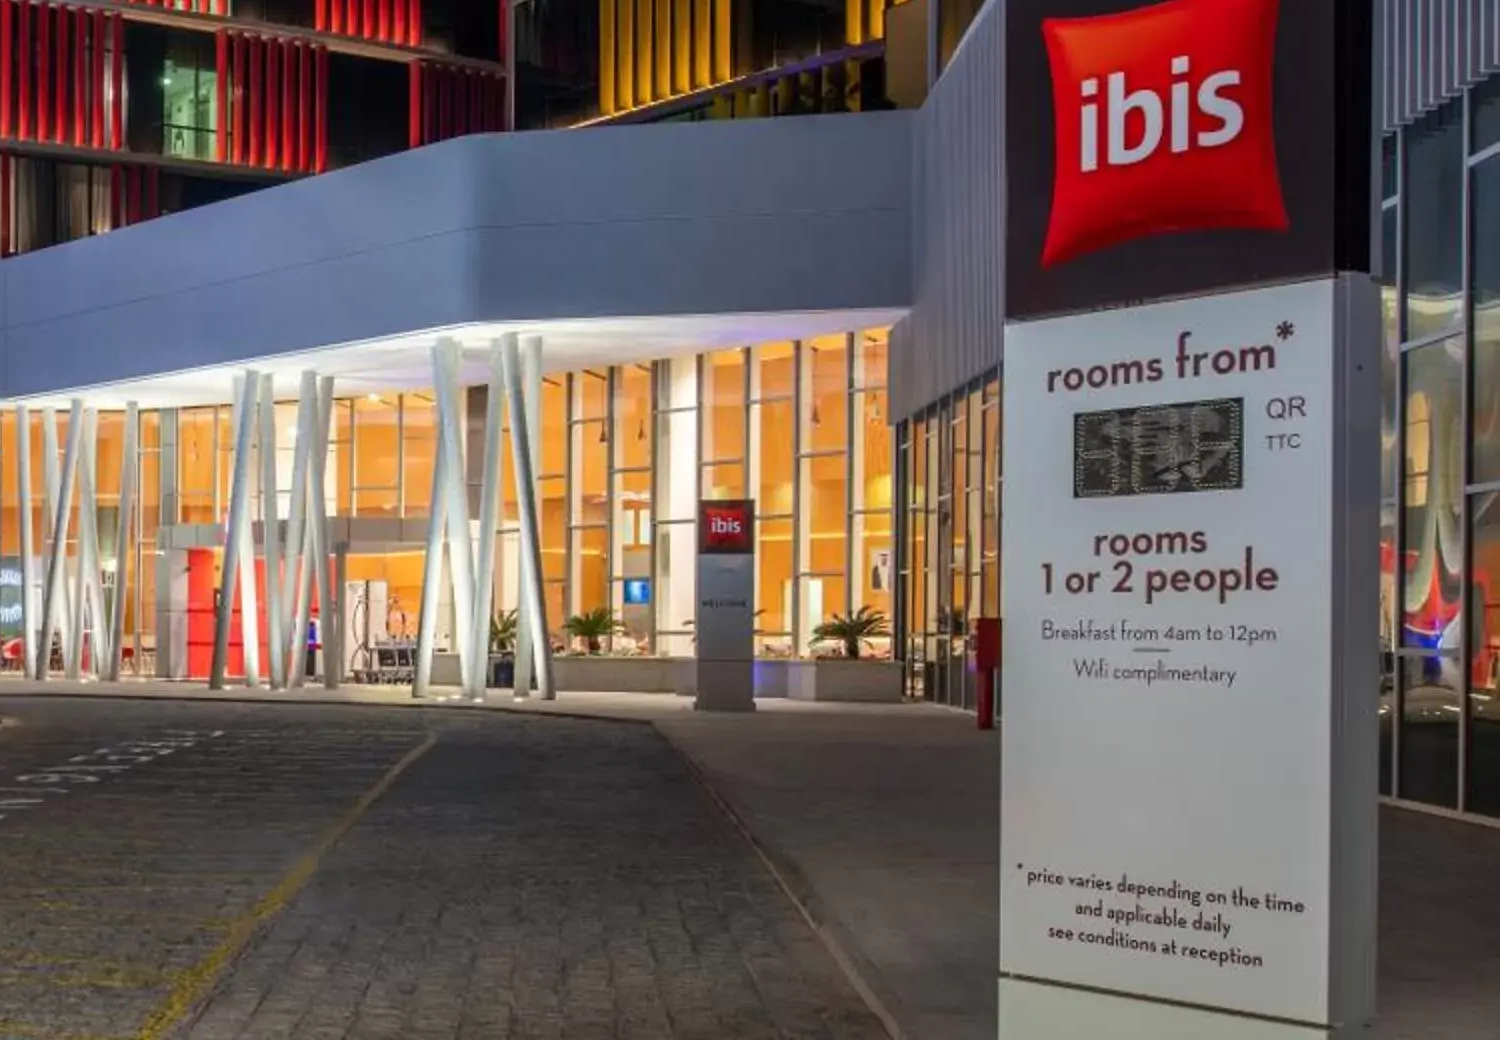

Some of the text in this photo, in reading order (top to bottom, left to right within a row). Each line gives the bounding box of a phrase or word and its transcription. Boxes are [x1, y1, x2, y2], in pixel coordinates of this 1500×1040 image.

[1080, 54, 1245, 173] ibis
[1047, 357, 1164, 394] rooms
[1265, 395, 1308, 422] QR
[1265, 433, 1302, 451] TTC
[711, 517, 742, 534] ibis
[1093, 530, 1208, 558] rooms
[1041, 545, 1280, 605] 1 or 2 people
[1041, 618, 1278, 646] Breakfast from 4am to 12pm
[1072, 657, 1238, 689] Wifi complimentary
[1068, 873, 1112, 892] varies
[1117, 874, 1201, 907] depending
[1205, 891, 1228, 906] on
[1232, 886, 1260, 909] the
[1265, 893, 1306, 914] time
[1075, 900, 1233, 939] and applicable daily
[1048, 925, 1264, 968] see conditions at reception
